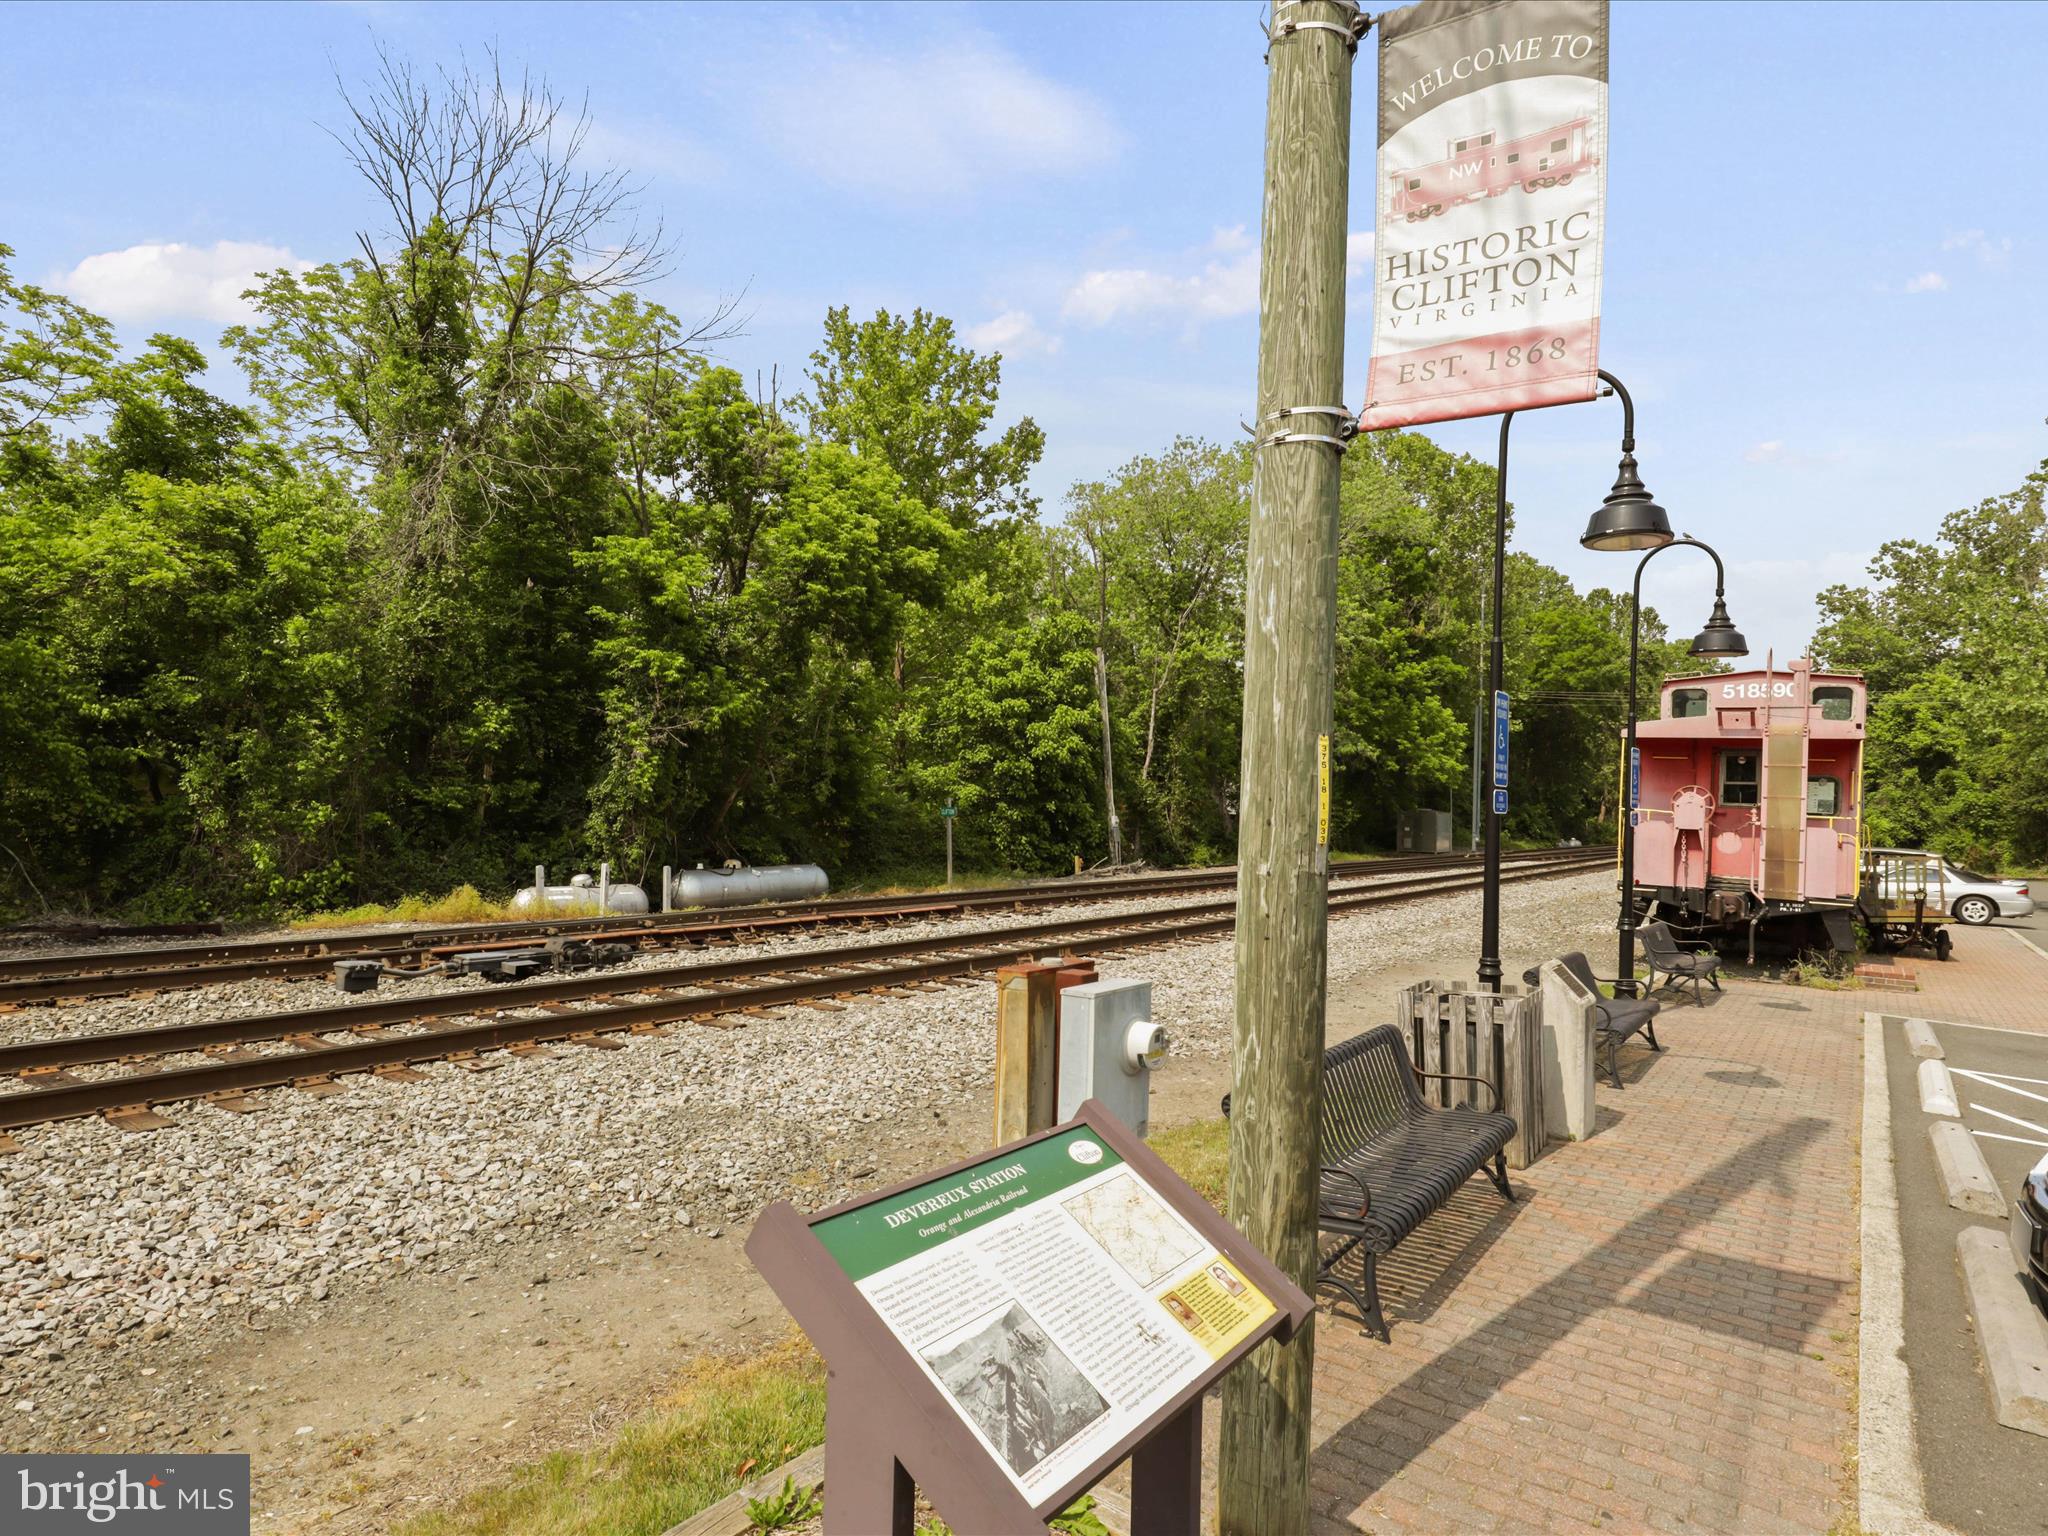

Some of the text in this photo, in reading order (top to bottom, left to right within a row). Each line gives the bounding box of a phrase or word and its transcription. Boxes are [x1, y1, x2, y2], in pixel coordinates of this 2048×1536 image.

[1390, 34, 1593, 113] WELCOME TO
[1449, 160, 1484, 181] NW
[1386, 211, 1591, 282] HISTORIC
[1390, 282, 1580, 329] VIRGINIA
[1391, 248, 1580, 311] CLIFTON
[1396, 336, 1568, 386] EST. 1868
[884, 1163, 1028, 1229] DEVEREUX STATION
[918, 1185, 1029, 1239] Orange and Alexandria Railroad
